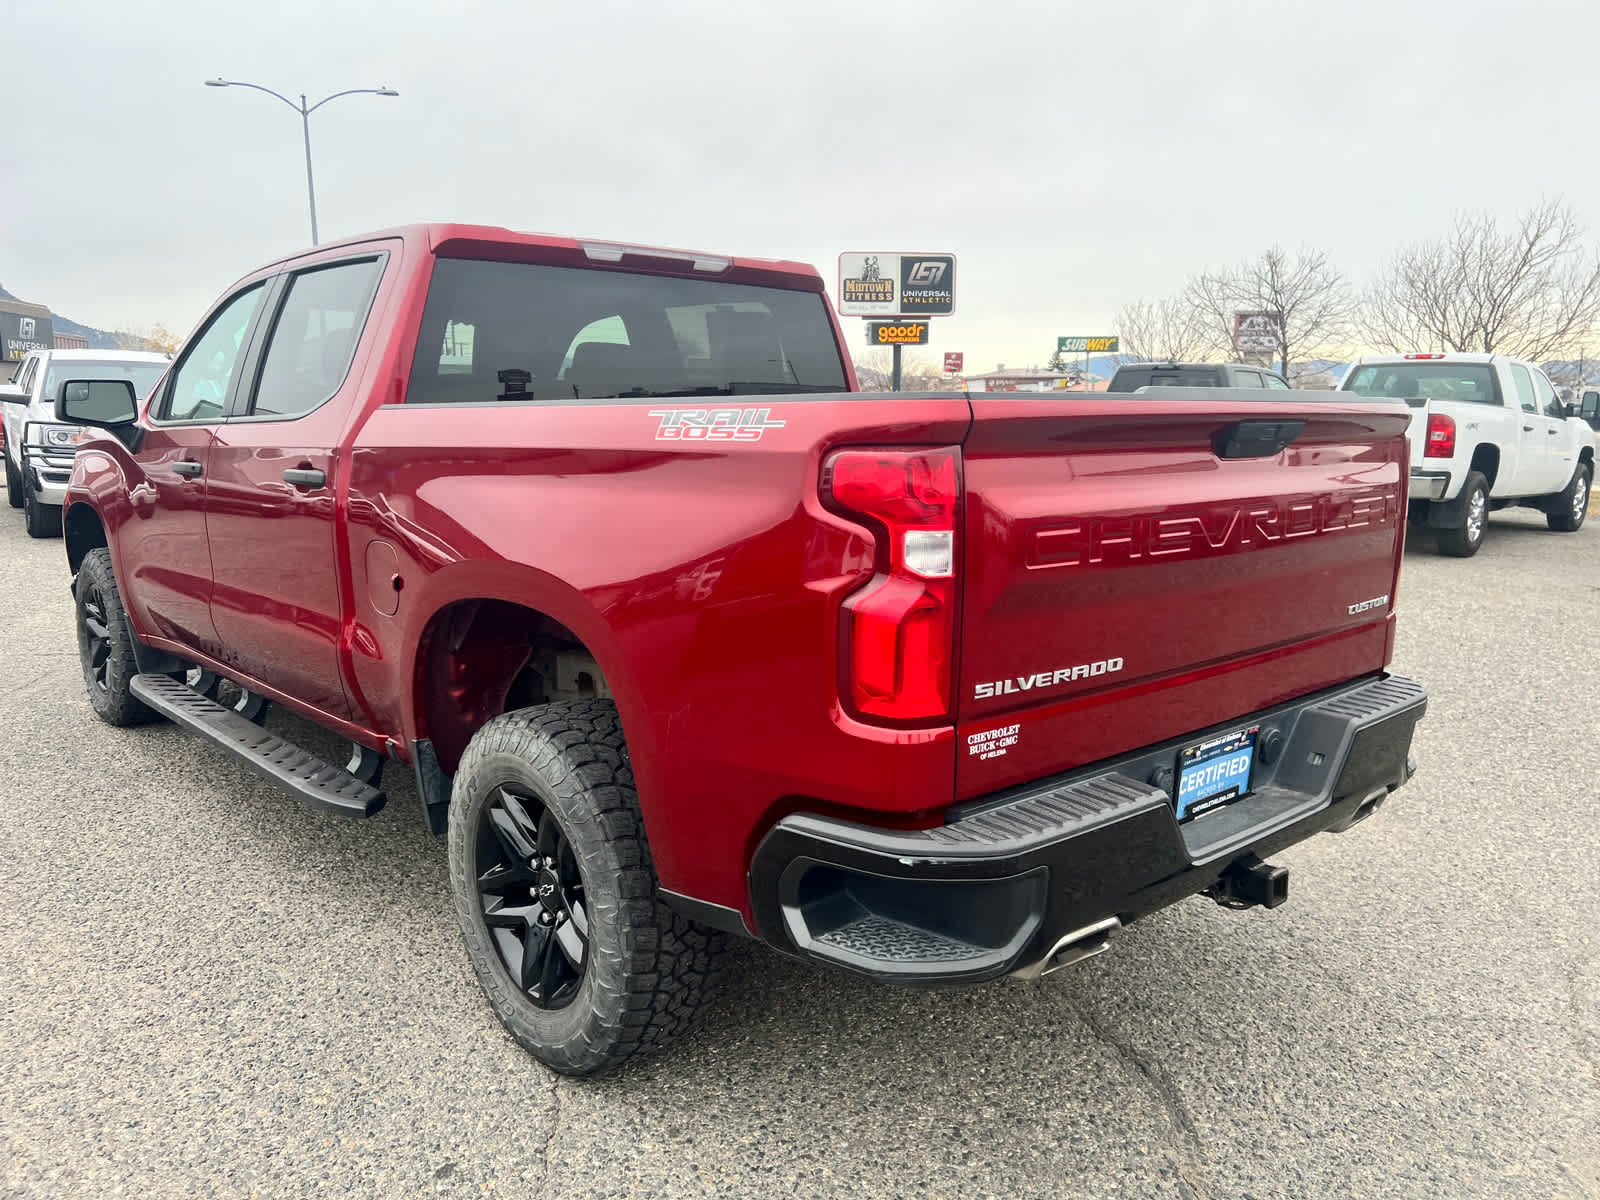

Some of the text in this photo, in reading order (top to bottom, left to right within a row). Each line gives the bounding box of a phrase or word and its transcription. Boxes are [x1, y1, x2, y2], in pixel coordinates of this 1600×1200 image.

[845, 292, 893, 301] FITNESS
[878, 323, 925, 343] goodr
[1061, 338, 1117, 351] SUBWAY
[648, 408, 787, 428] TRAIL
[655, 426, 765, 442] BOSS
[1025, 493, 1396, 570] CHEVROLET
[974, 657, 1124, 700] SILVERADO
[967, 724, 1021, 745] CHEVROLET
[1179, 755, 1249, 795] CERTIFIED
